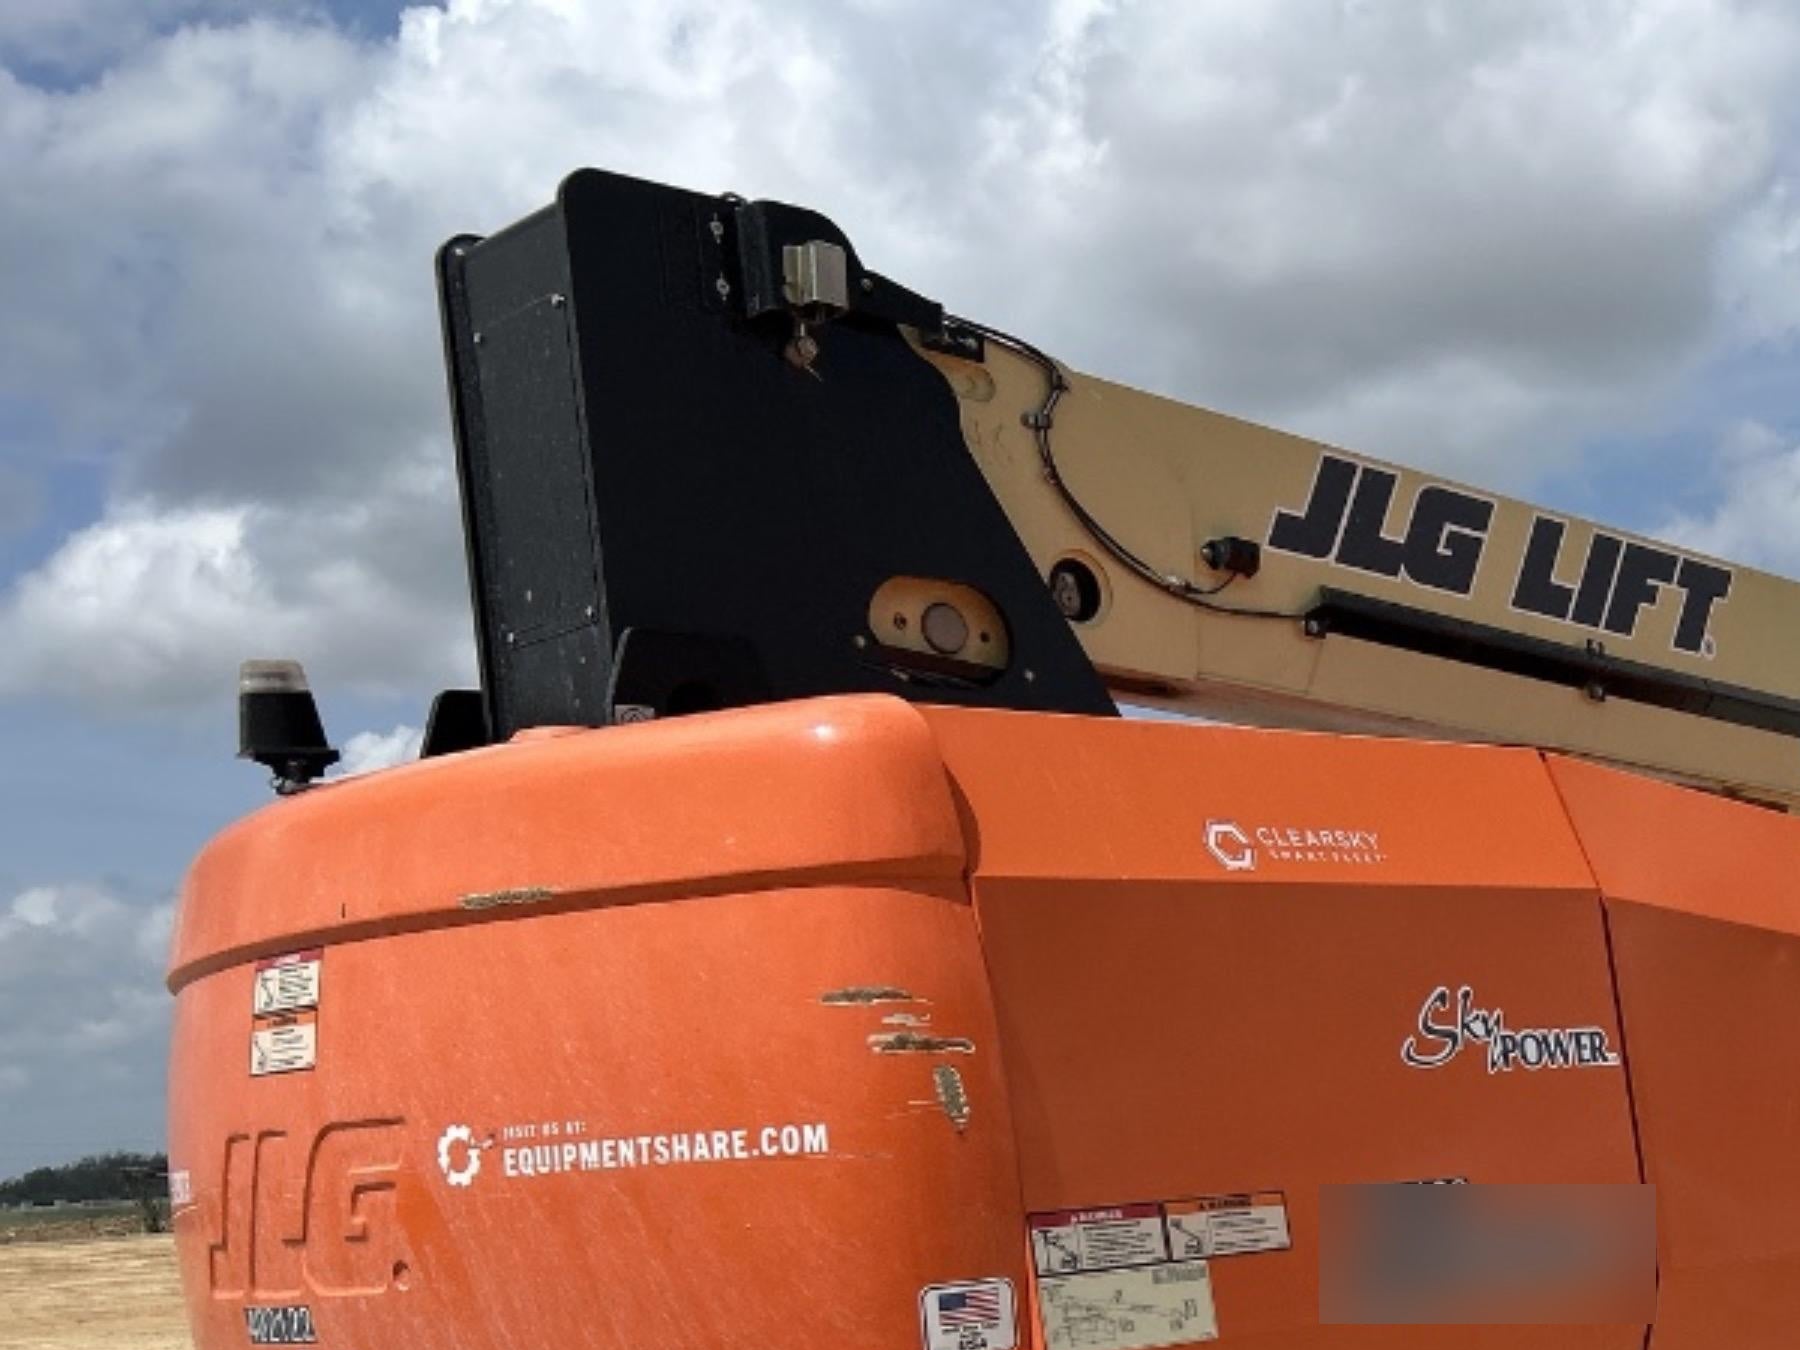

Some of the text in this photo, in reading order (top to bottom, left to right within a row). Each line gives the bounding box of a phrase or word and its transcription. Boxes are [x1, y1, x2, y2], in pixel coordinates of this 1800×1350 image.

[1266, 452, 1733, 658] JLG LIFT
[1256, 826, 1379, 850] CLEARSKY
[1401, 985, 1610, 1075] Sky POWER
[503, 1123, 830, 1178] EQUIPMENTSHARE.COM
